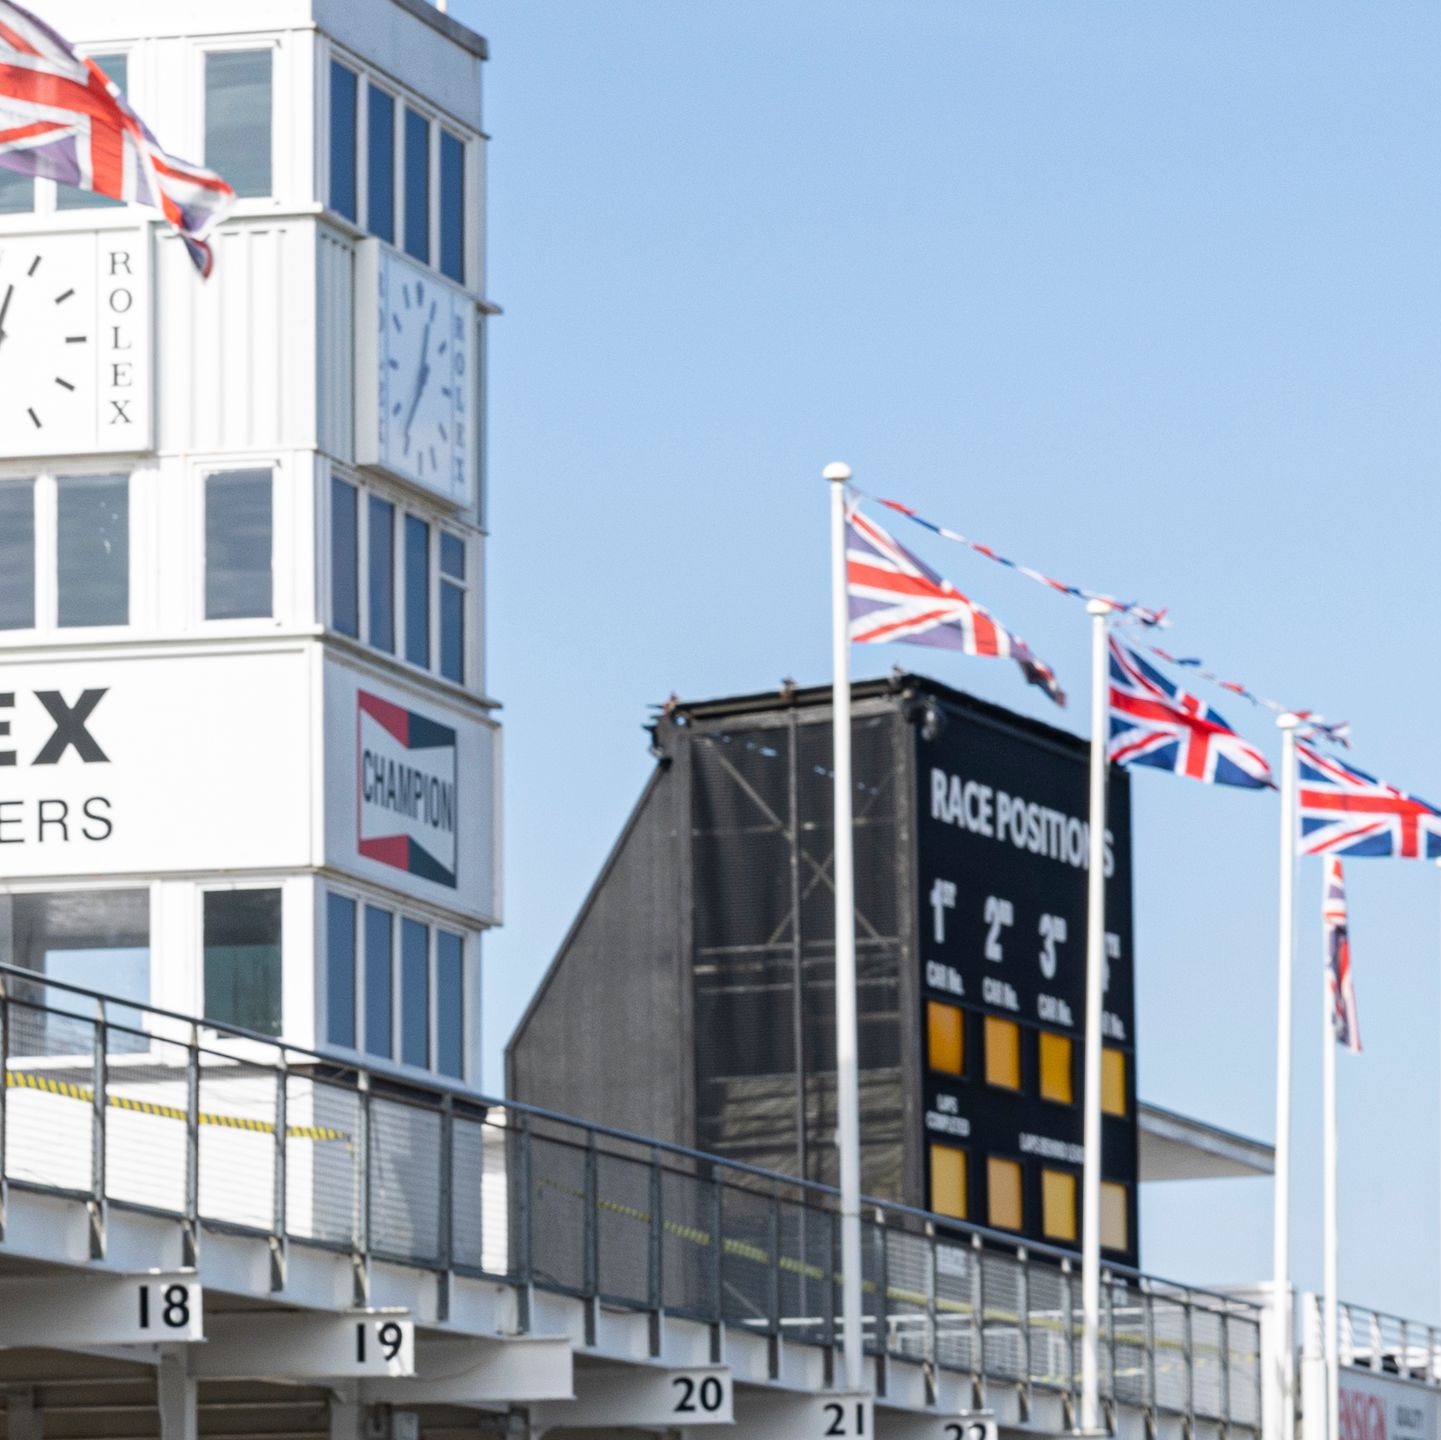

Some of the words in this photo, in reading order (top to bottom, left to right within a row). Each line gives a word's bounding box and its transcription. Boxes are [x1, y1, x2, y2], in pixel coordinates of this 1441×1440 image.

[109, 251, 133, 424] ROLEX
[362, 749, 454, 832] CHAMPION
[931, 767, 993, 838] RACE
[139, 1284, 190, 1328] 18
[357, 1322, 402, 1362] 19
[672, 1377, 723, 1412] 20
[823, 1403, 865, 1437] 21
